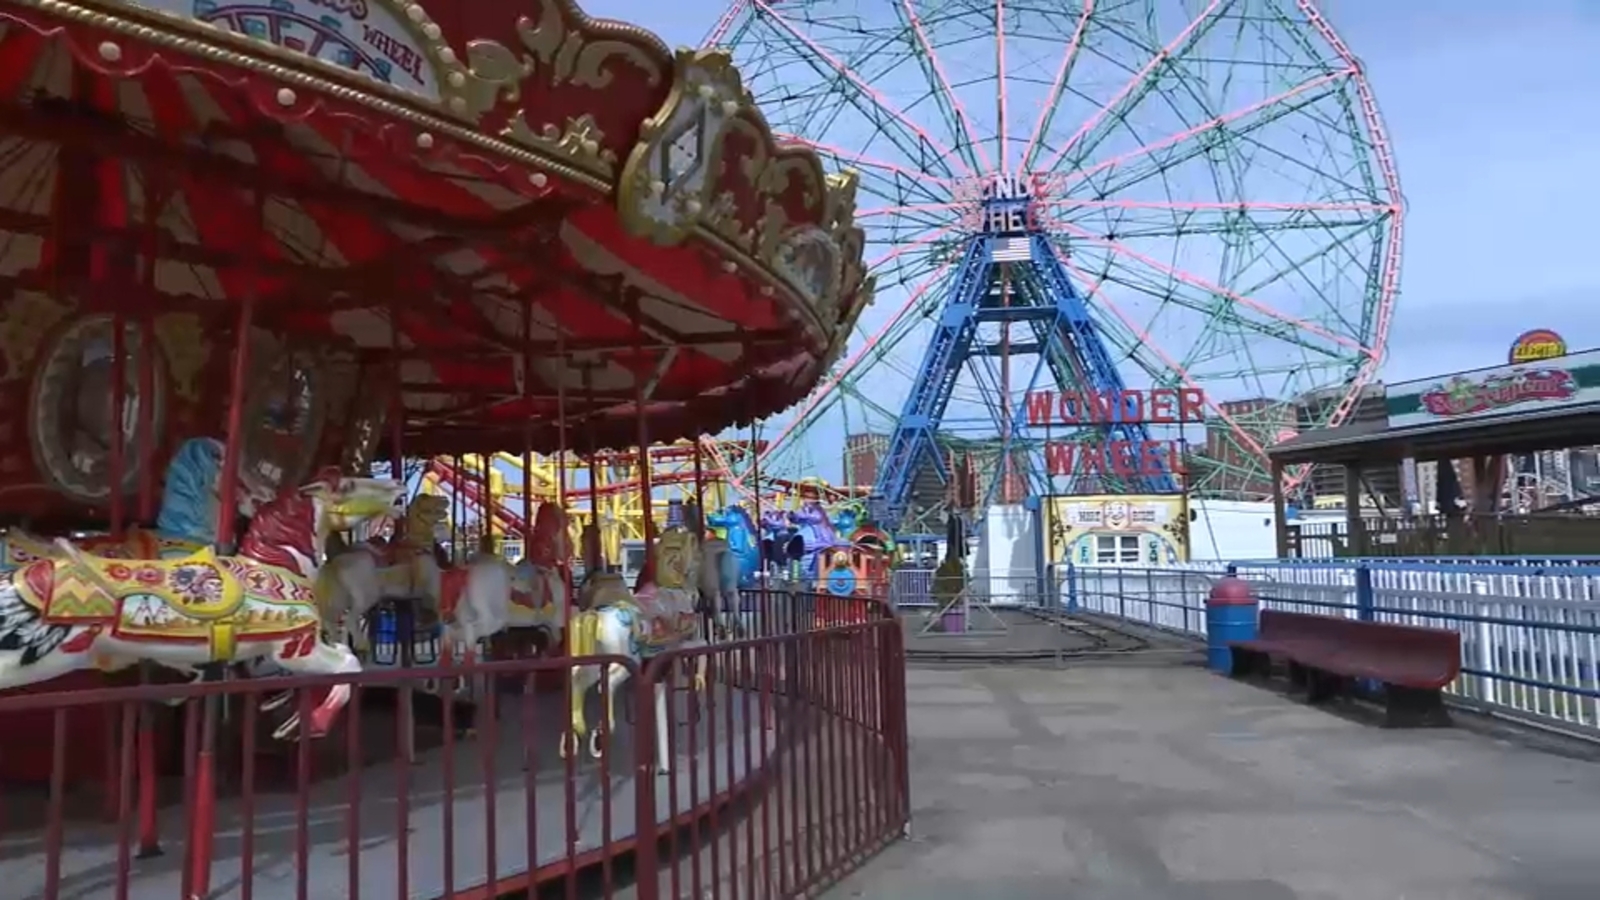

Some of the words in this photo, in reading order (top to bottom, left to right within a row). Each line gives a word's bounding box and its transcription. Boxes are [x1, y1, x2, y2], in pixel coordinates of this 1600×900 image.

[363, 23, 425, 86] WHEEL
[1026, 388, 1204, 423] WONDER
[1046, 439, 1187, 477] WHEEL
